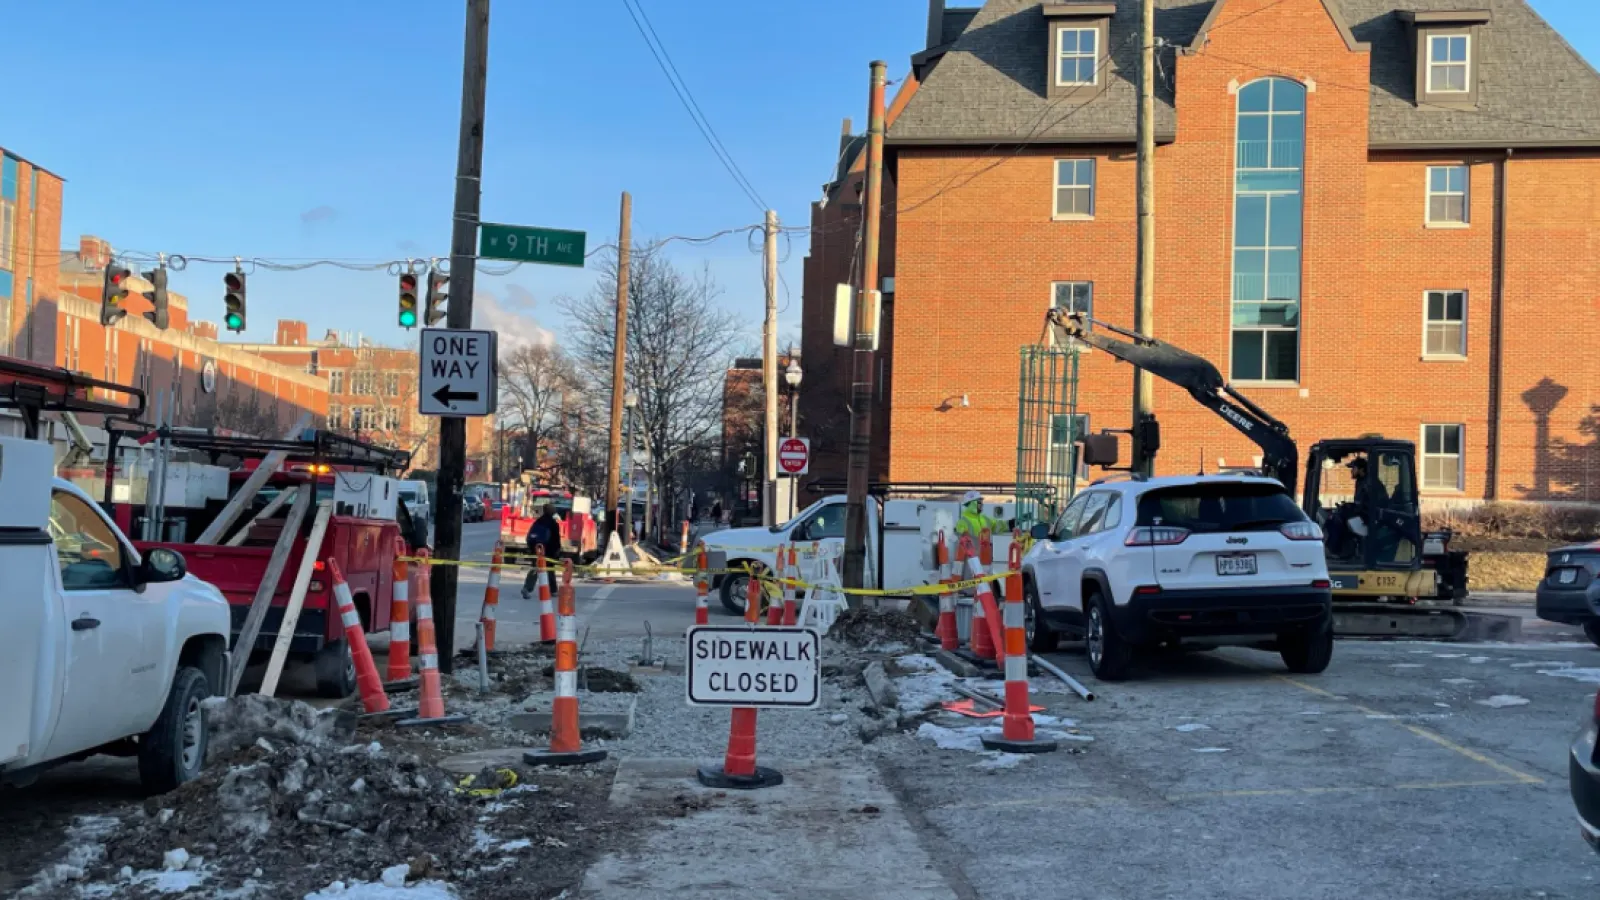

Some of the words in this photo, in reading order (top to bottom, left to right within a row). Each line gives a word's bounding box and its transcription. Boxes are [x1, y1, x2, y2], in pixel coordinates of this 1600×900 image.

[507, 234, 518, 252] 9
[525, 235, 549, 256] TH
[556, 242, 573, 253] AVE
[433, 336, 478, 357] ONE
[431, 359, 480, 379] WAY
[1220, 403, 1254, 431] DEERE
[784, 459, 802, 467] ENTER
[1225, 535, 1249, 546] Jeep
[696, 640, 811, 661] SIDEWALK
[708, 672, 799, 693] CLOSED
